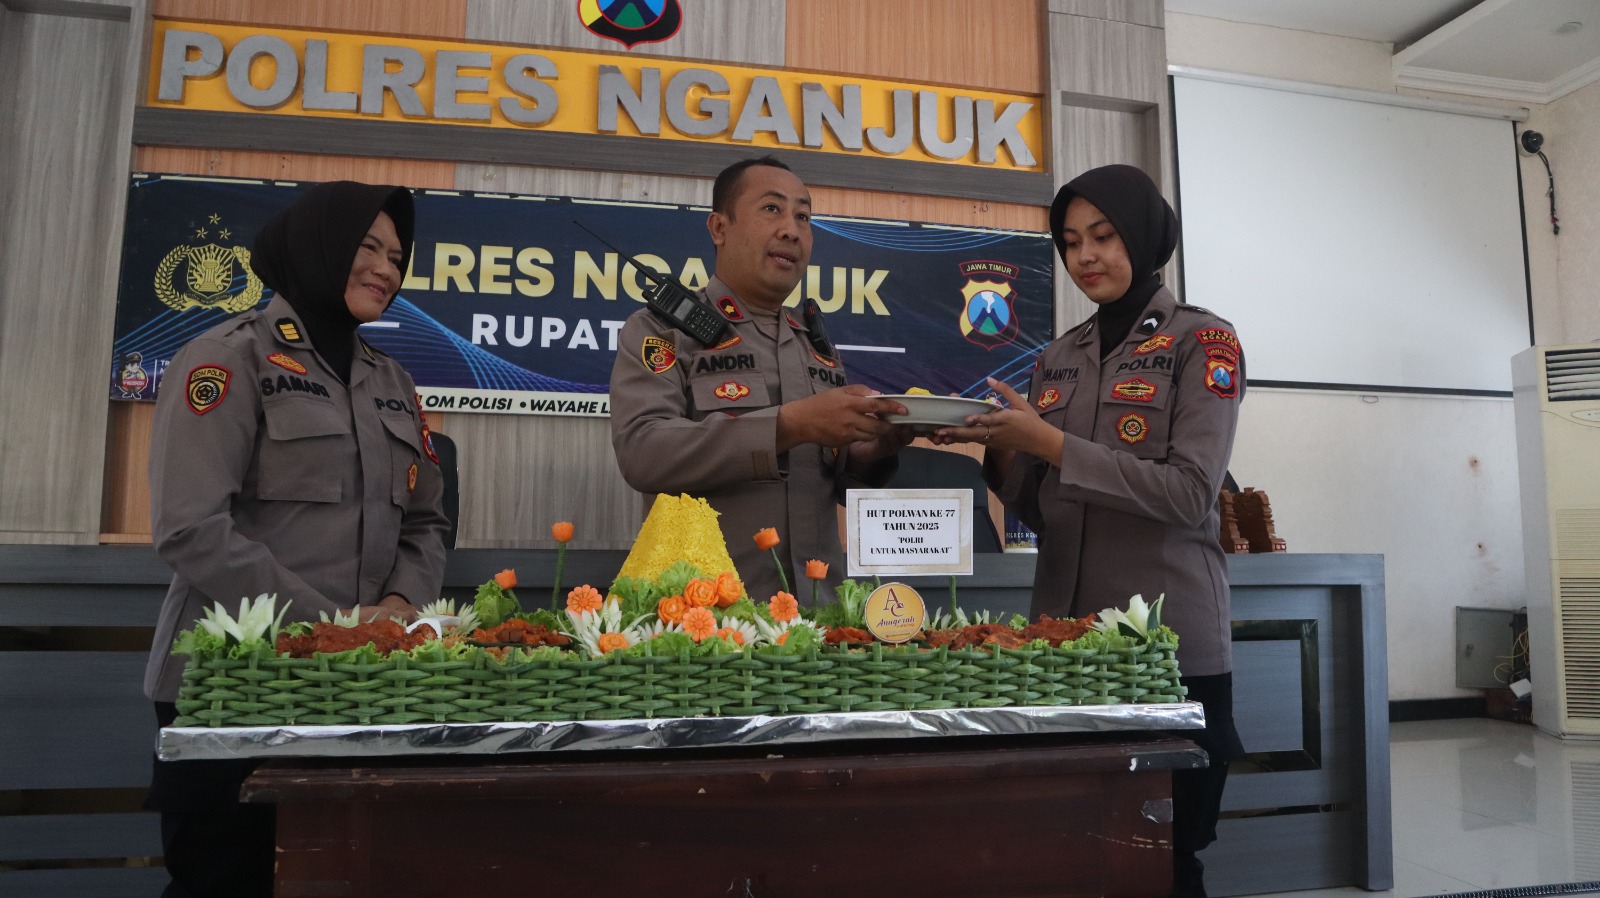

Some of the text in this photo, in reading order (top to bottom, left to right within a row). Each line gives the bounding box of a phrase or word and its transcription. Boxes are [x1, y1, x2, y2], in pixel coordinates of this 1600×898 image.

[158, 29, 1037, 167] POLRES NGANJUK
[401, 241, 891, 316] LRES NGAUK
[966, 263, 1012, 275] JAWA TIMUR
[471, 313, 626, 351] RUPAT
[696, 354, 755, 373] ANDRI
[1115, 355, 1173, 374] POLRI
[207, 369, 225, 380] POLRI
[374, 397, 415, 418] POL
[425, 395, 454, 408] OM
[458, 396, 513, 411] POLISI
[530, 399, 599, 414] WAYAHE
[867, 509, 887, 518] HUT
[889, 509, 928, 518] POLWAN
[883, 522, 940, 531] TAHUN 2025
[870, 547, 897, 555] UNTUK
